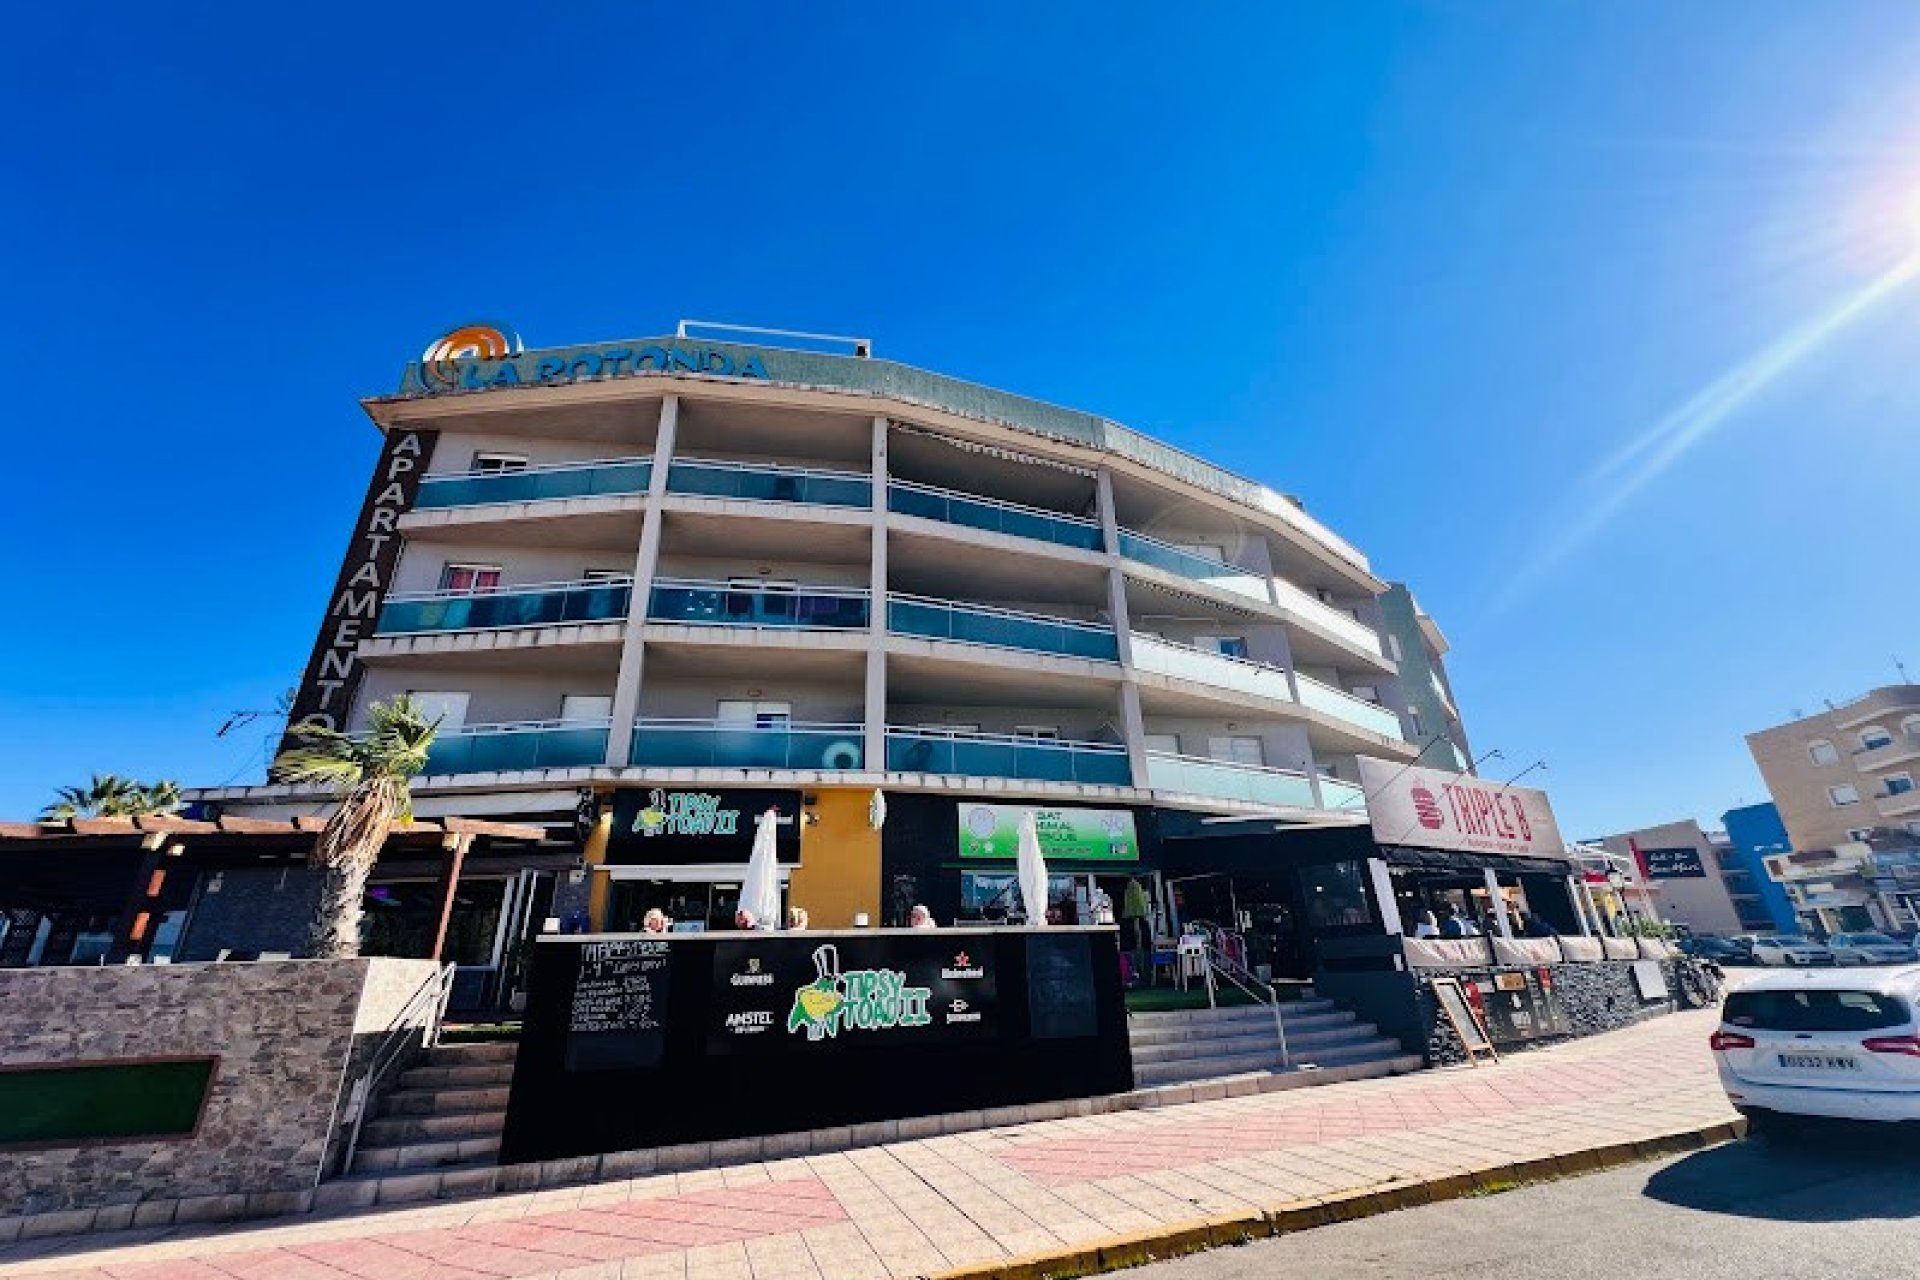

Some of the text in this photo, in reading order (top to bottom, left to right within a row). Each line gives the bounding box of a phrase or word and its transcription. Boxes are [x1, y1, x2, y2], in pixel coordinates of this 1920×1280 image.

[466, 347, 772, 389] LA ROTONDA
[1441, 783, 1515, 839] TRIPLE
[843, 969, 905, 1001] TIPSY
[726, 1011, 774, 1026] AMSTEL
[843, 987, 931, 1030] TOAD II
